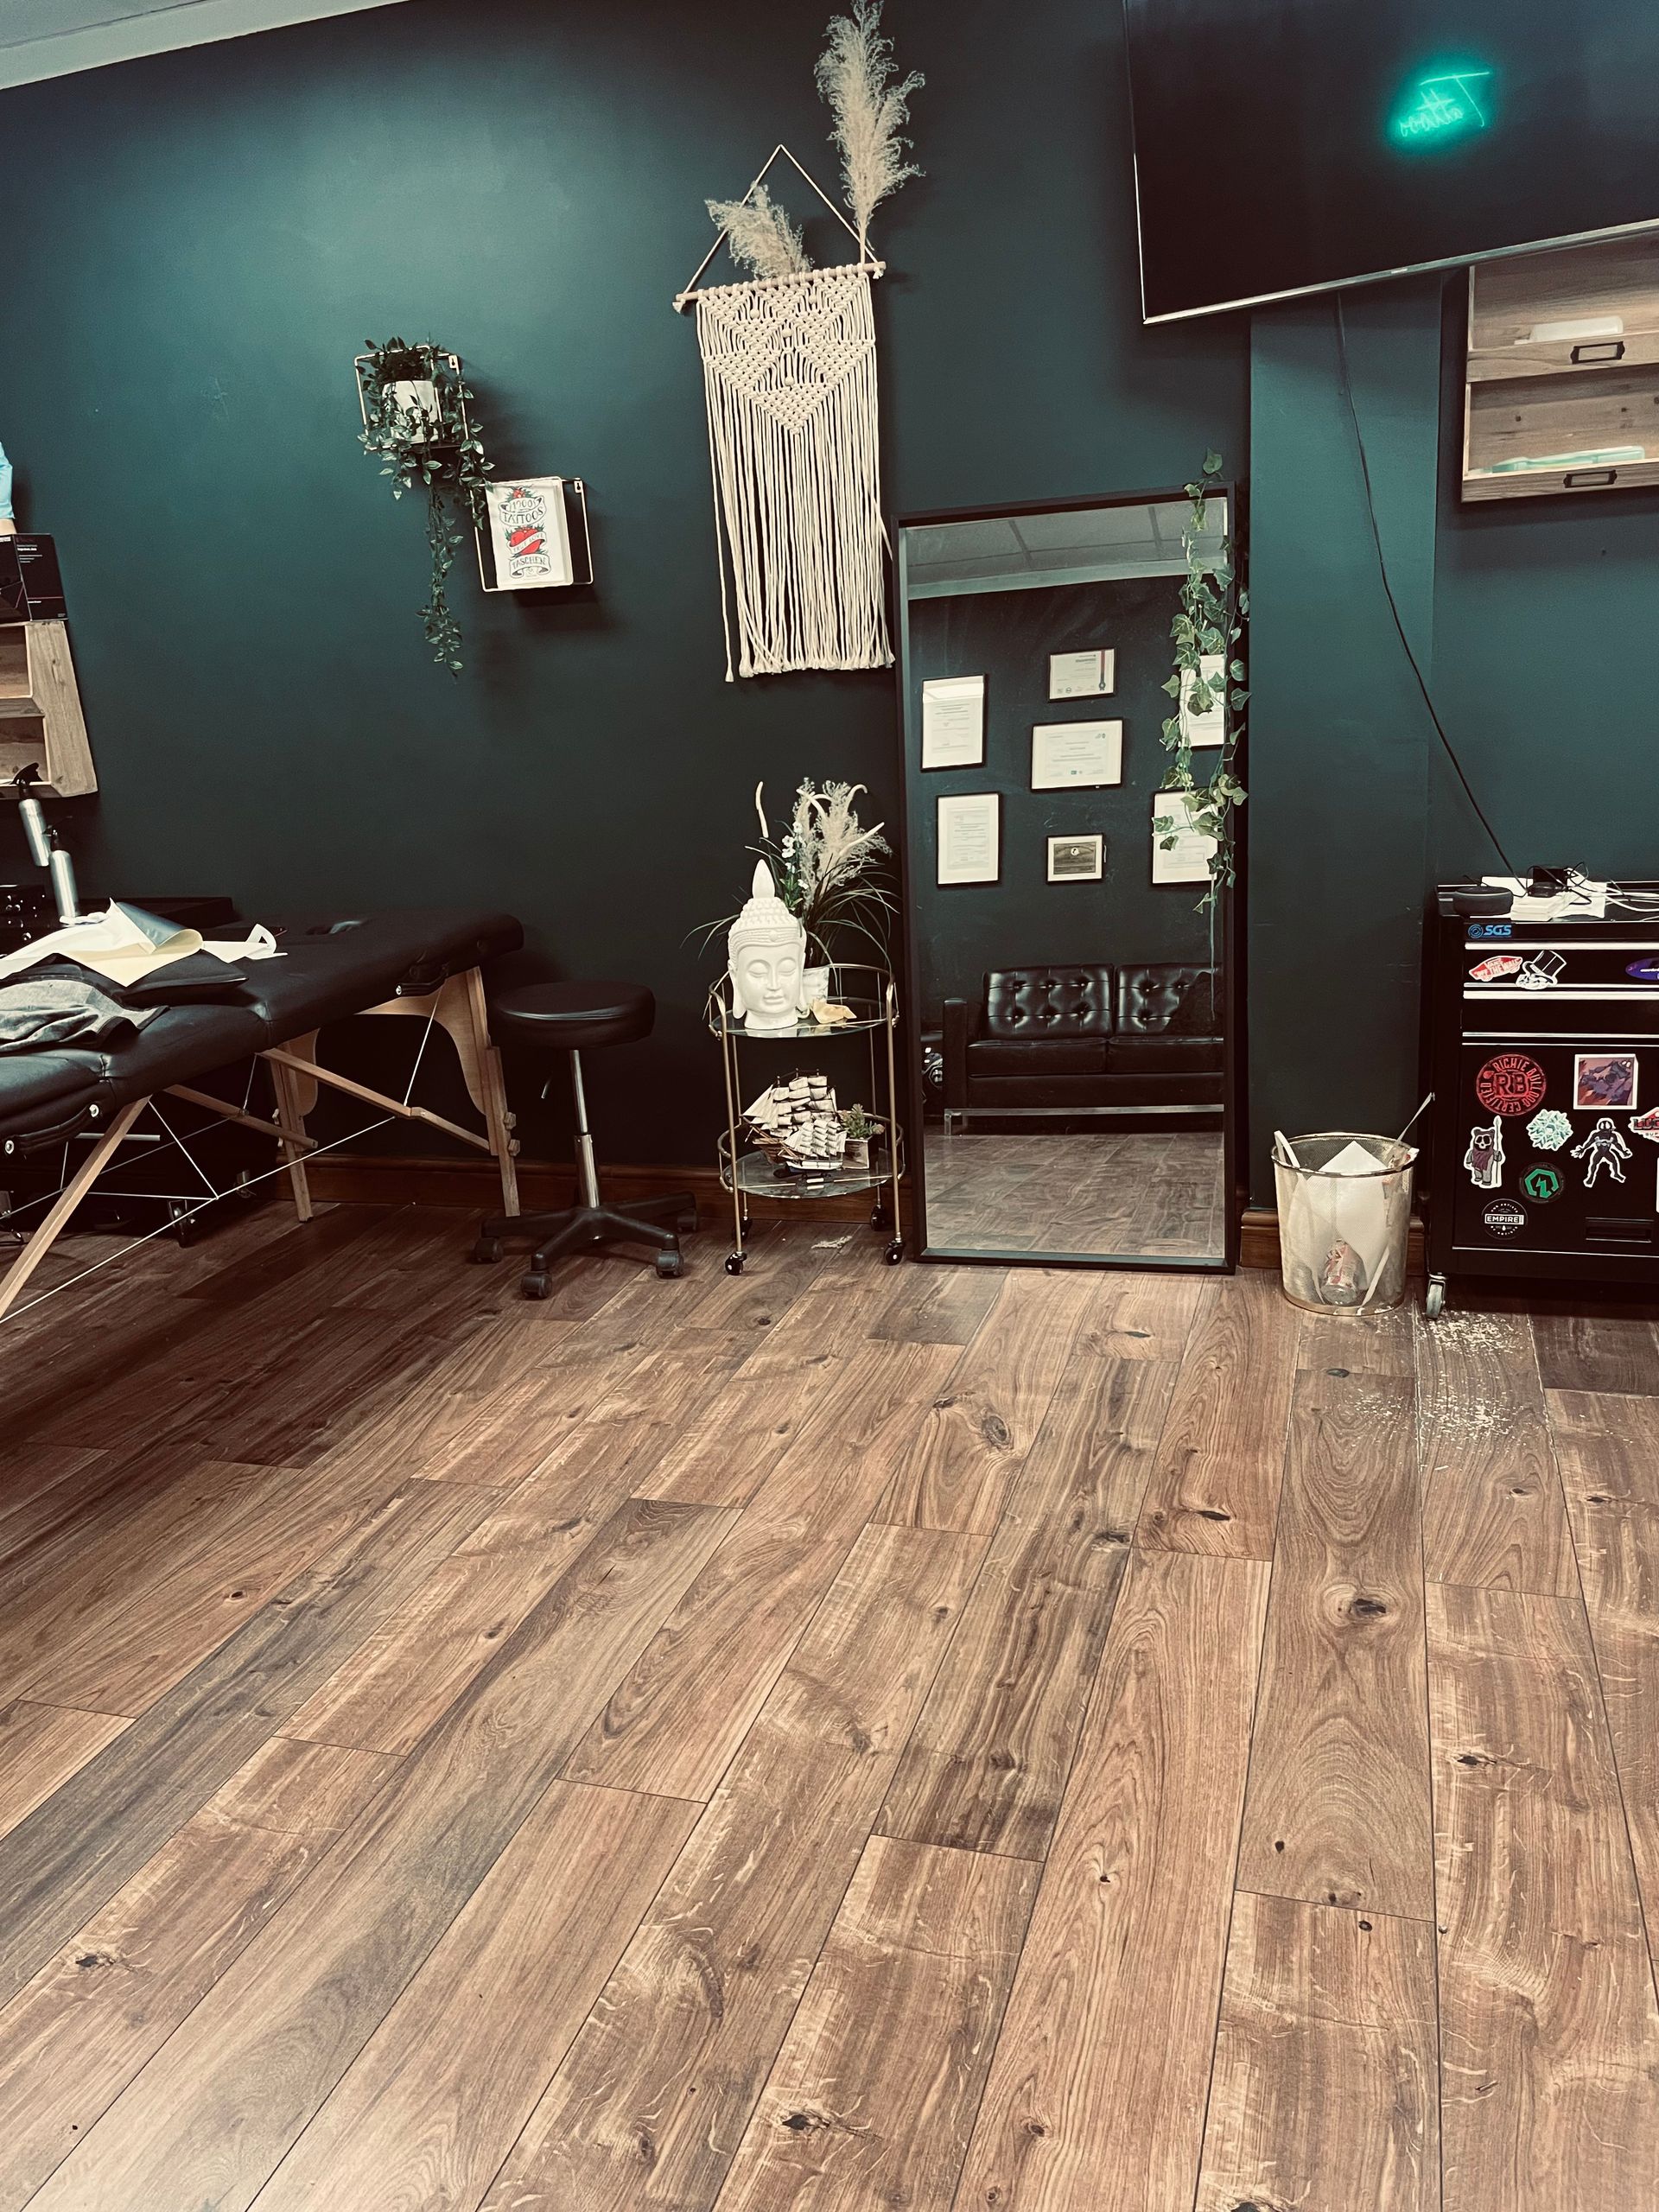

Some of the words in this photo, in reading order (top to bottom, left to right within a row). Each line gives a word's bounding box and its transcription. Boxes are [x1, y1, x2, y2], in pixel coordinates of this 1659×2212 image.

[512, 499, 532, 510] 1000
[503, 506, 543, 524] TATTOOS
[512, 556, 546, 569] TASCHEN
[1484, 925, 1511, 936] SGS
[1492, 1058, 1530, 1072] RICHIE
[1495, 1072, 1527, 1095] RB
[1522, 1067, 1542, 1108] BULLDOG
[1480, 1082, 1522, 1112] CERTIFIED
[1486, 1215, 1519, 1224] EMPIRE
